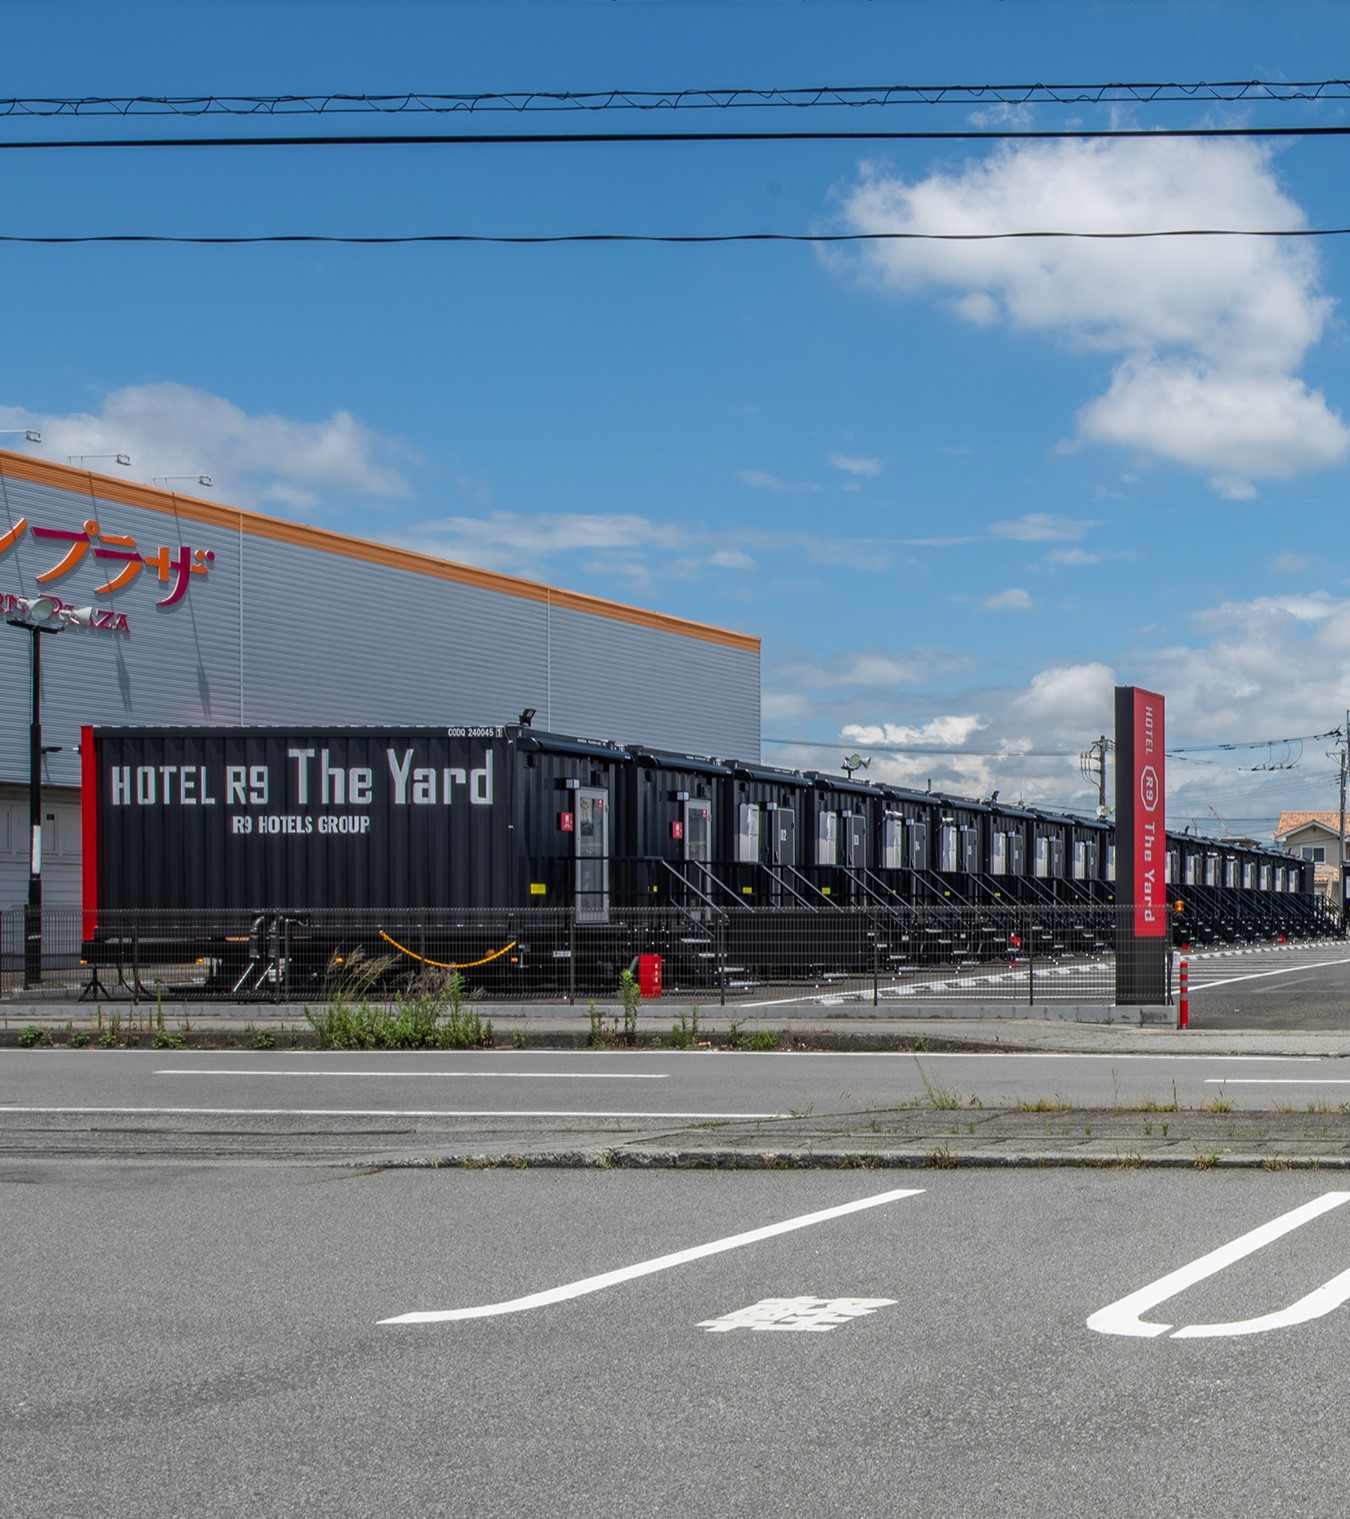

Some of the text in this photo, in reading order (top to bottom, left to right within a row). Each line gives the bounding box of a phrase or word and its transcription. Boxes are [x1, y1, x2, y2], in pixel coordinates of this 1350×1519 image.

[468, 728, 494, 737] 240045
[111, 748, 494, 805] HOTEL R9 The Yard
[232, 815, 370, 834] R9 HOTELS GROUP
[1144, 706, 1155, 921] HOTEL R9 The Yard
[694, 1296, 899, 1332] 軽
